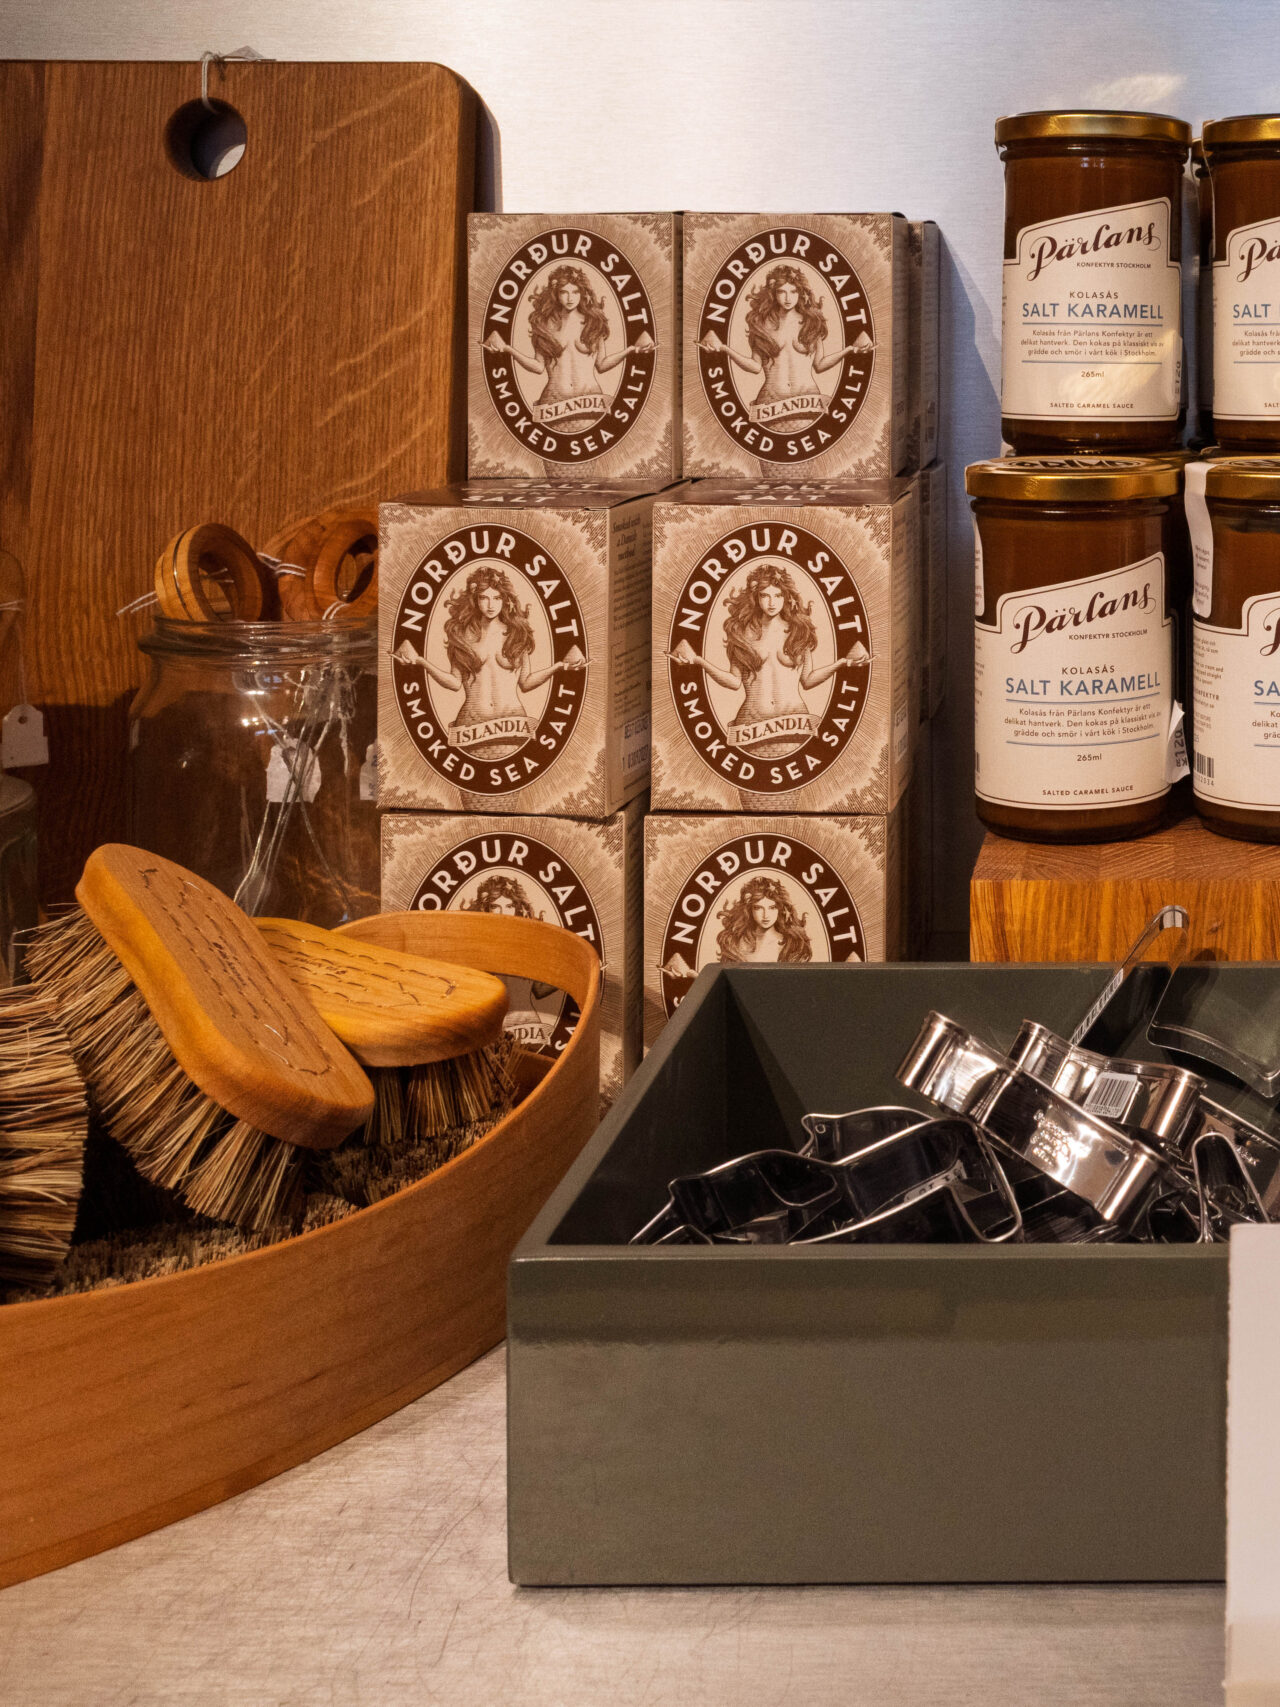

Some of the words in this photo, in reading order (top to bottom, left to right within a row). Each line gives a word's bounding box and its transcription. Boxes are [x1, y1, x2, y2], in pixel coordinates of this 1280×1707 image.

[1026, 222, 1162, 282] Pärlans
[491, 232, 593, 324] NORÐUR
[600, 252, 650, 328] SALT
[706, 233, 812, 324] NORÐUR
[818, 252, 868, 327] SALT
[1069, 290, 1119, 300] KOLASÅS
[1022, 303, 1060, 318] SALT
[1067, 303, 1164, 320] KARAMELL
[1233, 304, 1271, 318] SALT
[1080, 370, 1105, 378] 265ml
[493, 367, 558, 453] SMOKED
[570, 429, 614, 457] SEA
[614, 365, 647, 423] SALT
[538, 398, 608, 421] ISLANDIA
[708, 366, 774, 453] SMOKED
[787, 428, 832, 456] SEA
[832, 364, 863, 424] SALT
[756, 398, 824, 421] ISLANDIA
[402, 530, 516, 632] NORÐUR
[525, 554, 579, 638] SALT
[678, 528, 798, 632] NORÐUR
[806, 551, 862, 634] SALT
[1010, 582, 1156, 654] Pärlans
[1069, 633, 1110, 641] KONFEKTYR
[1112, 629, 1148, 638] STOCKHOLM
[1062, 664, 1115, 675] KOLASÅS
[1006, 677, 1051, 696] SALT
[1060, 672, 1161, 696] KARAMELL
[403, 682, 476, 780] SMOKED
[490, 760, 540, 786] SEA
[540, 685, 577, 751] SALT
[454, 719, 532, 746] ISLANDIA
[680, 681, 756, 781] SMOKED
[770, 759, 821, 785] SEA
[822, 680, 860, 748] SALT
[734, 718, 814, 745] ISLANDIA
[1077, 754, 1102, 762] 265ml
[1073, 788, 1109, 796] CARAMEL
[1111, 785, 1134, 794] SAUCE
[418, 839, 530, 912] ORÐUR
[539, 862, 596, 943] SALT
[672, 840, 793, 945] NORÐUR
[801, 863, 859, 945] SALT
